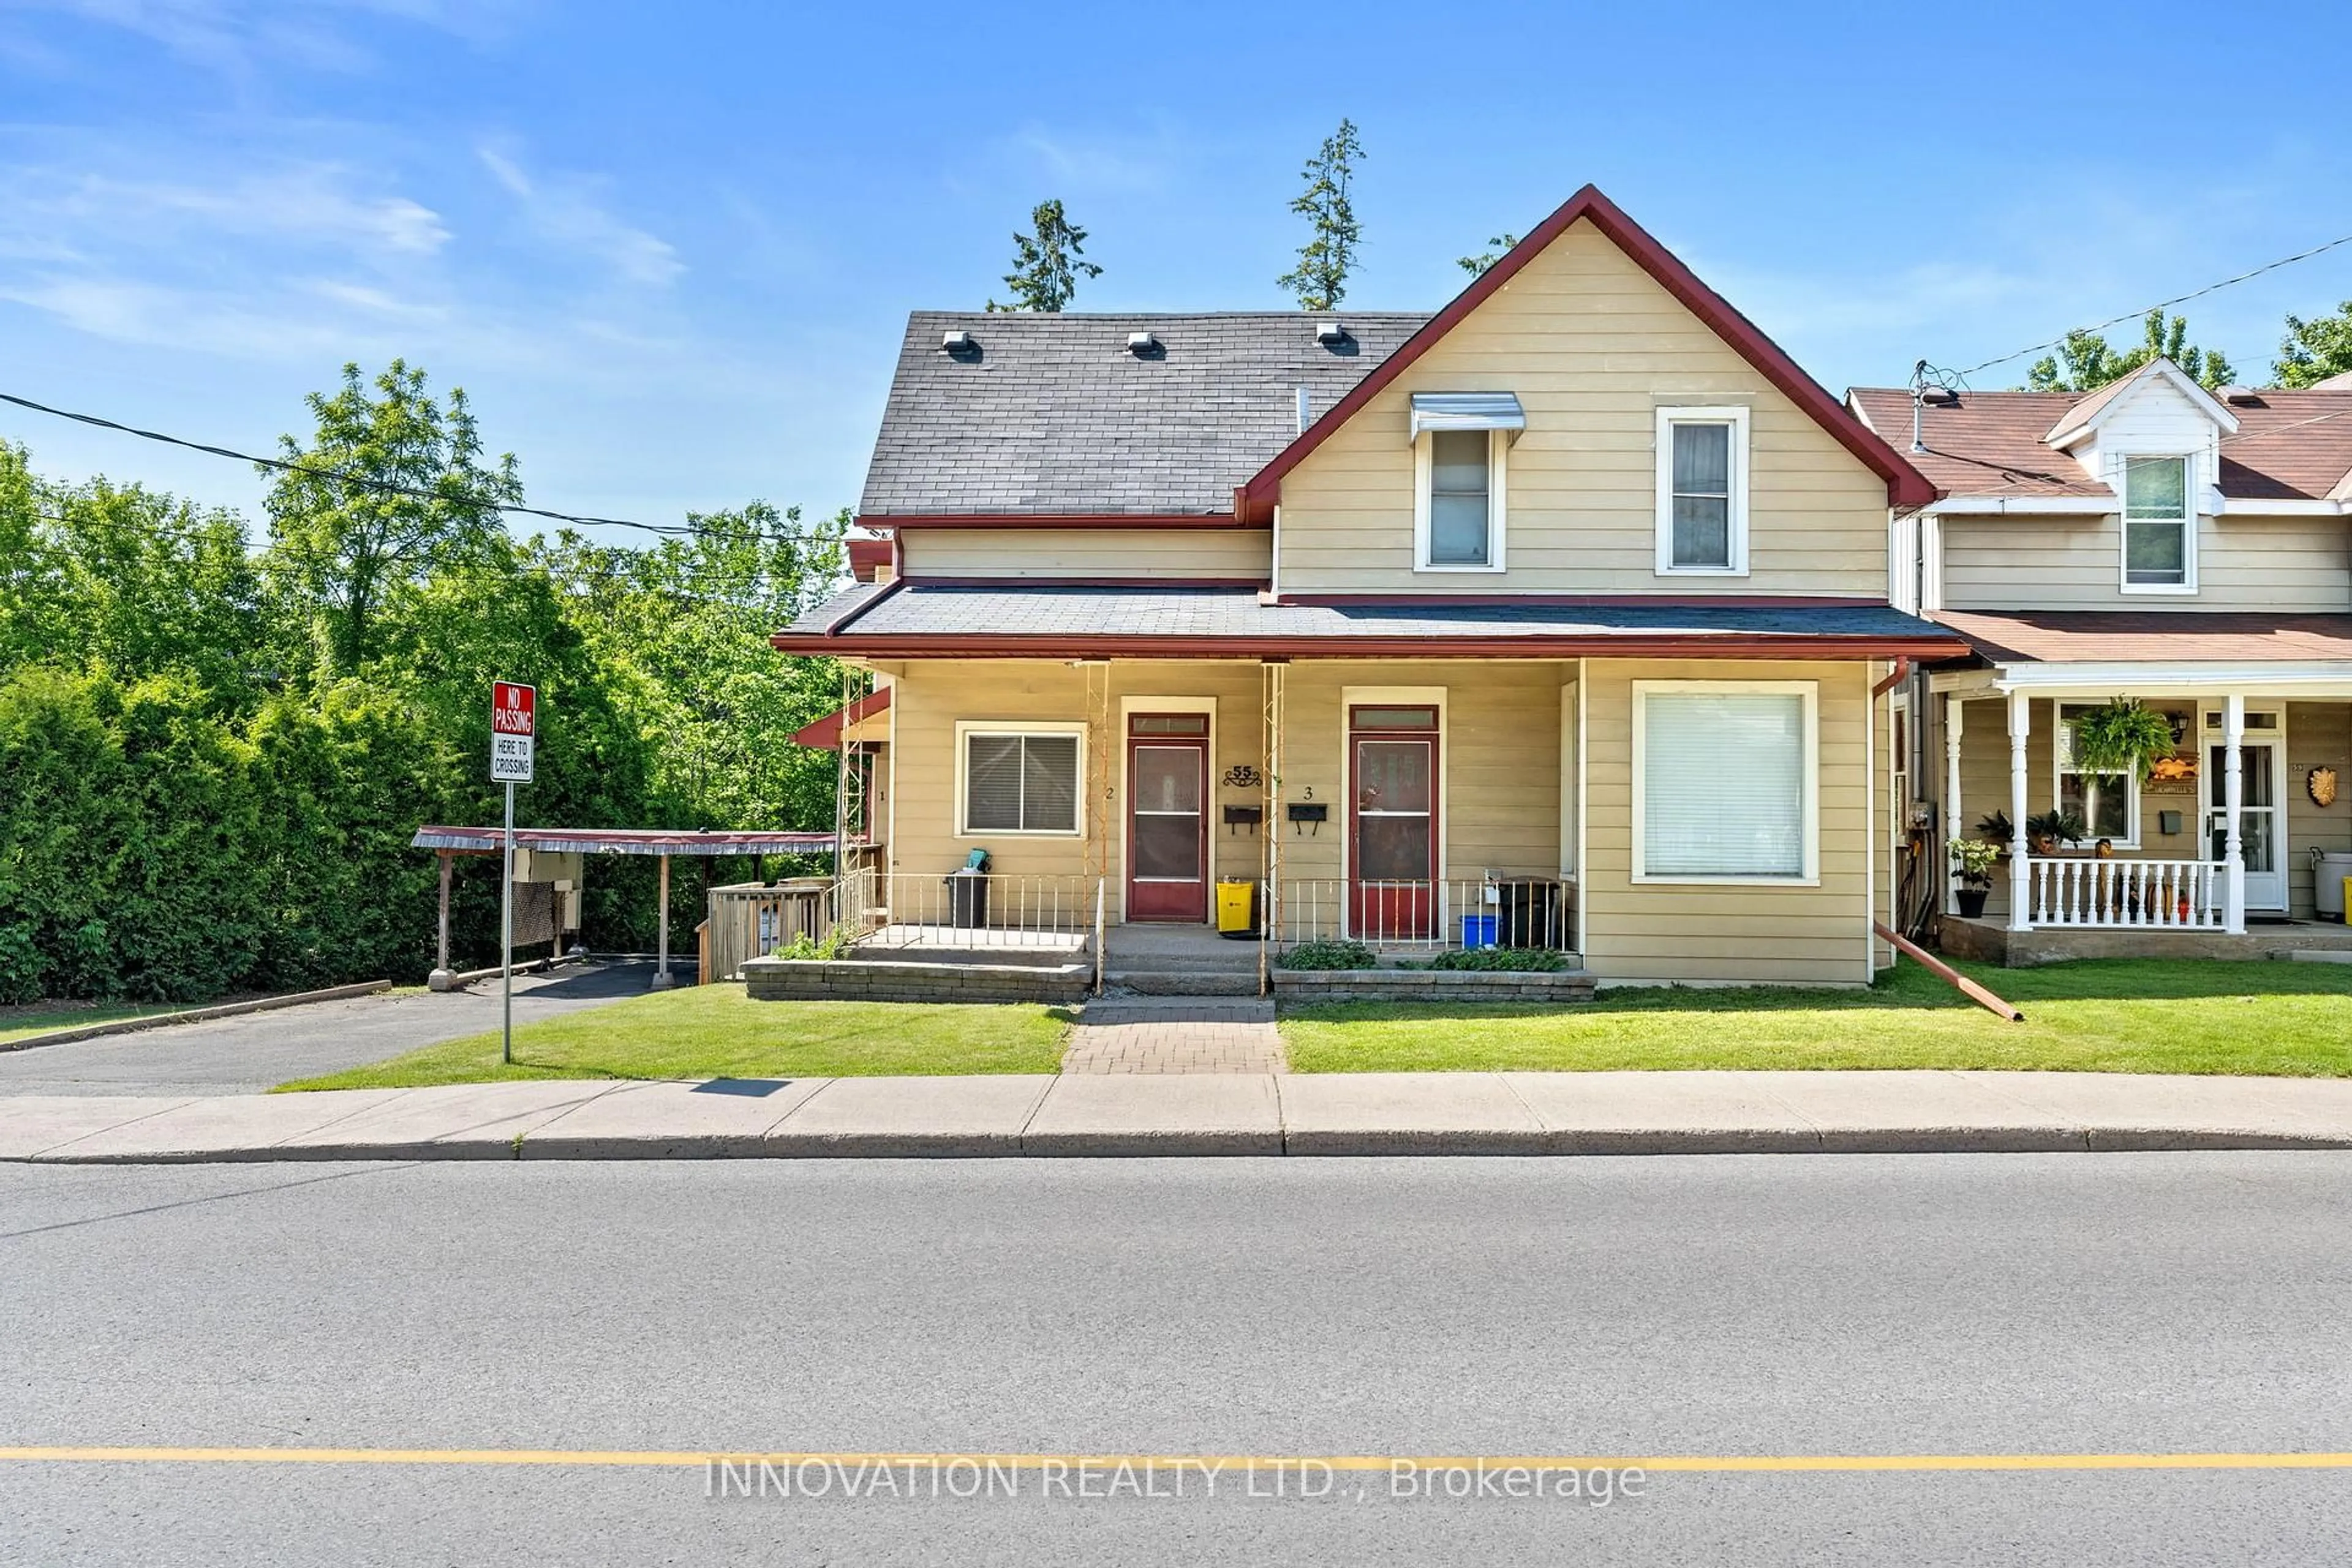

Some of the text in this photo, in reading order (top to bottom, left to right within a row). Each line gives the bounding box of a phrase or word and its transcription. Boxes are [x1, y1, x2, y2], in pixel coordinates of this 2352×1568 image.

[508, 687, 520, 710] NO
[495, 708, 532, 733] PASSING
[498, 739, 527, 755] HERE TO
[495, 758, 529, 774] CROSSING
[1233, 766, 1251, 778] 55
[1106, 786, 1114, 799] 2
[1303, 786, 1313, 801] 3
